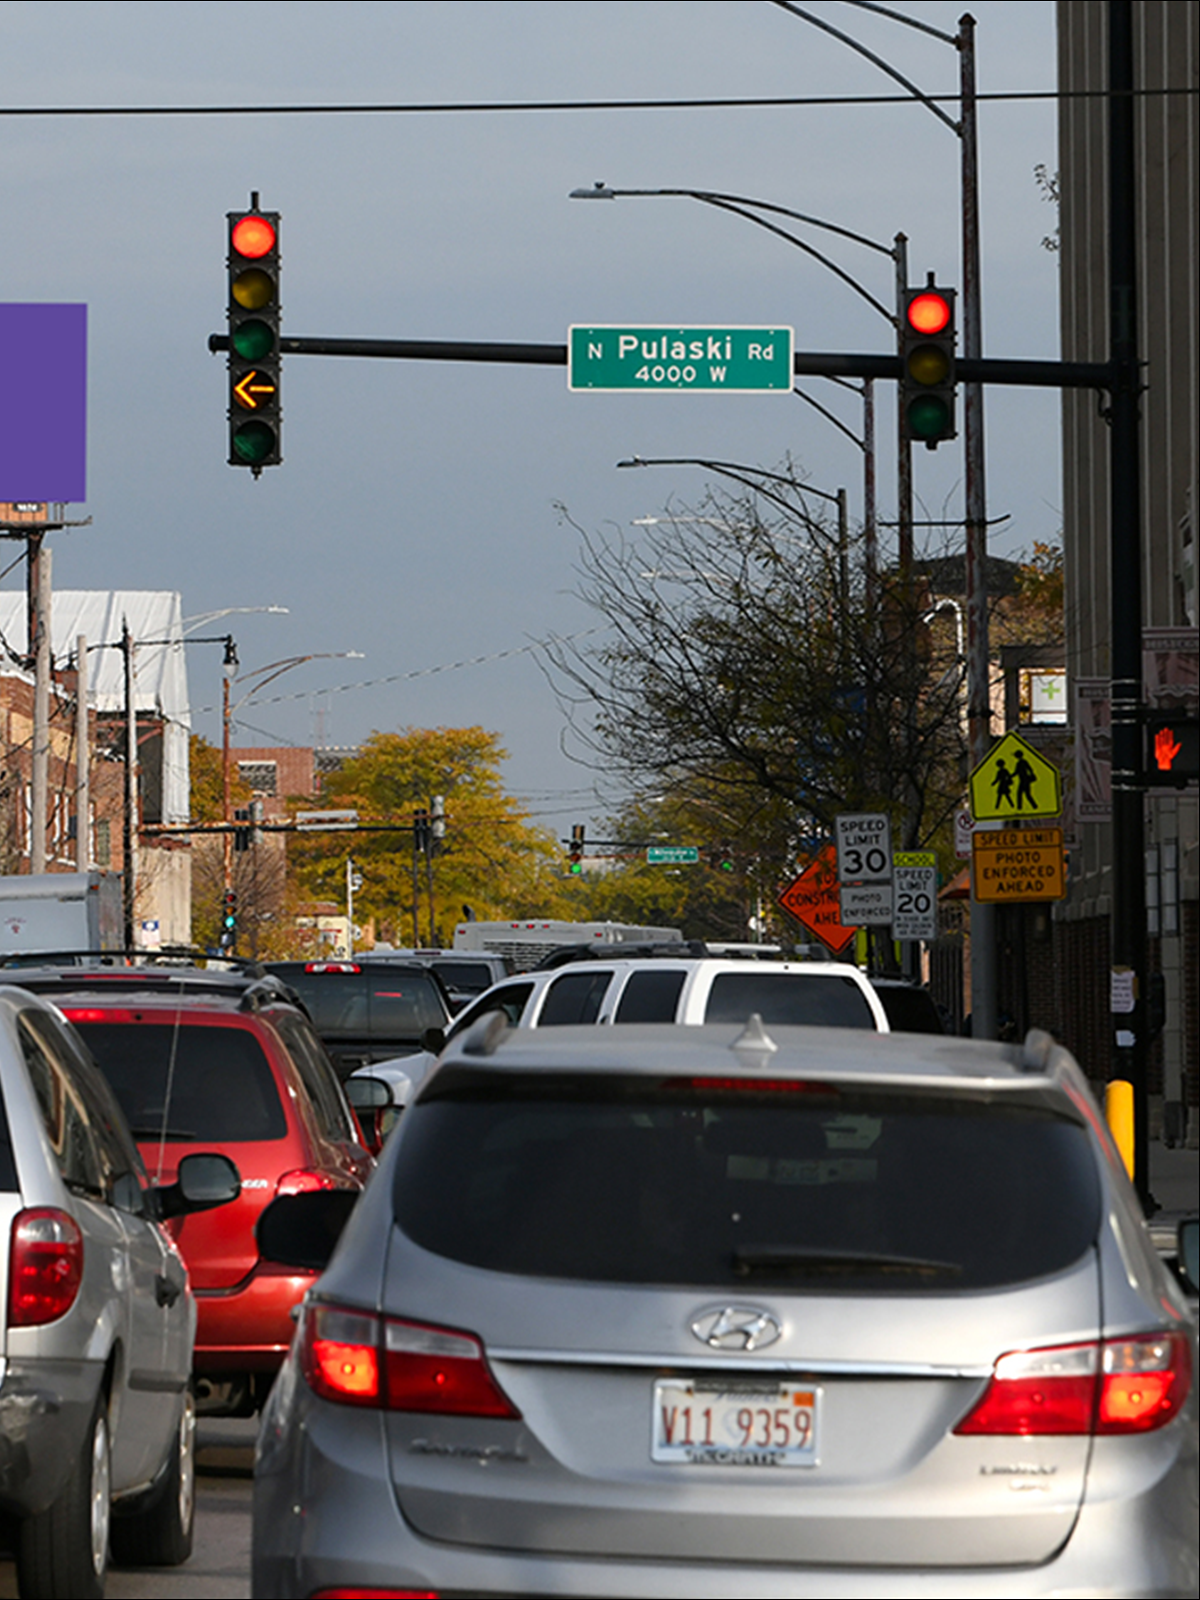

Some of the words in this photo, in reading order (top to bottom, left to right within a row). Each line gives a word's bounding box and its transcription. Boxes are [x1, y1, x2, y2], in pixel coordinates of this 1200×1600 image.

[588, 342, 602, 360] N
[618, 335, 732, 360] Pulaski
[748, 343, 774, 360] Rd
[634, 365, 696, 382] 4000
[709, 365, 727, 382] W
[840, 819, 885, 832] SPEED
[845, 834, 881, 847] LIMIT
[980, 833, 1017, 846] SPEED
[1023, 831, 1054, 845] LIMIT
[843, 848, 886, 874] 30
[895, 853, 932, 866] SCHOOL
[996, 851, 1041, 863] PHOTO
[896, 869, 932, 881] SPEED
[983, 865, 1055, 879] ENFORCED
[900, 880, 927, 891] LIMIT
[996, 880, 1044, 893] AHEAD
[851, 893, 882, 903] PHOTO
[897, 893, 930, 913] 20
[843, 907, 891, 919] ENFORCED
[662, 1405, 715, 1446] V11
[736, 1407, 812, 1448] 9359
